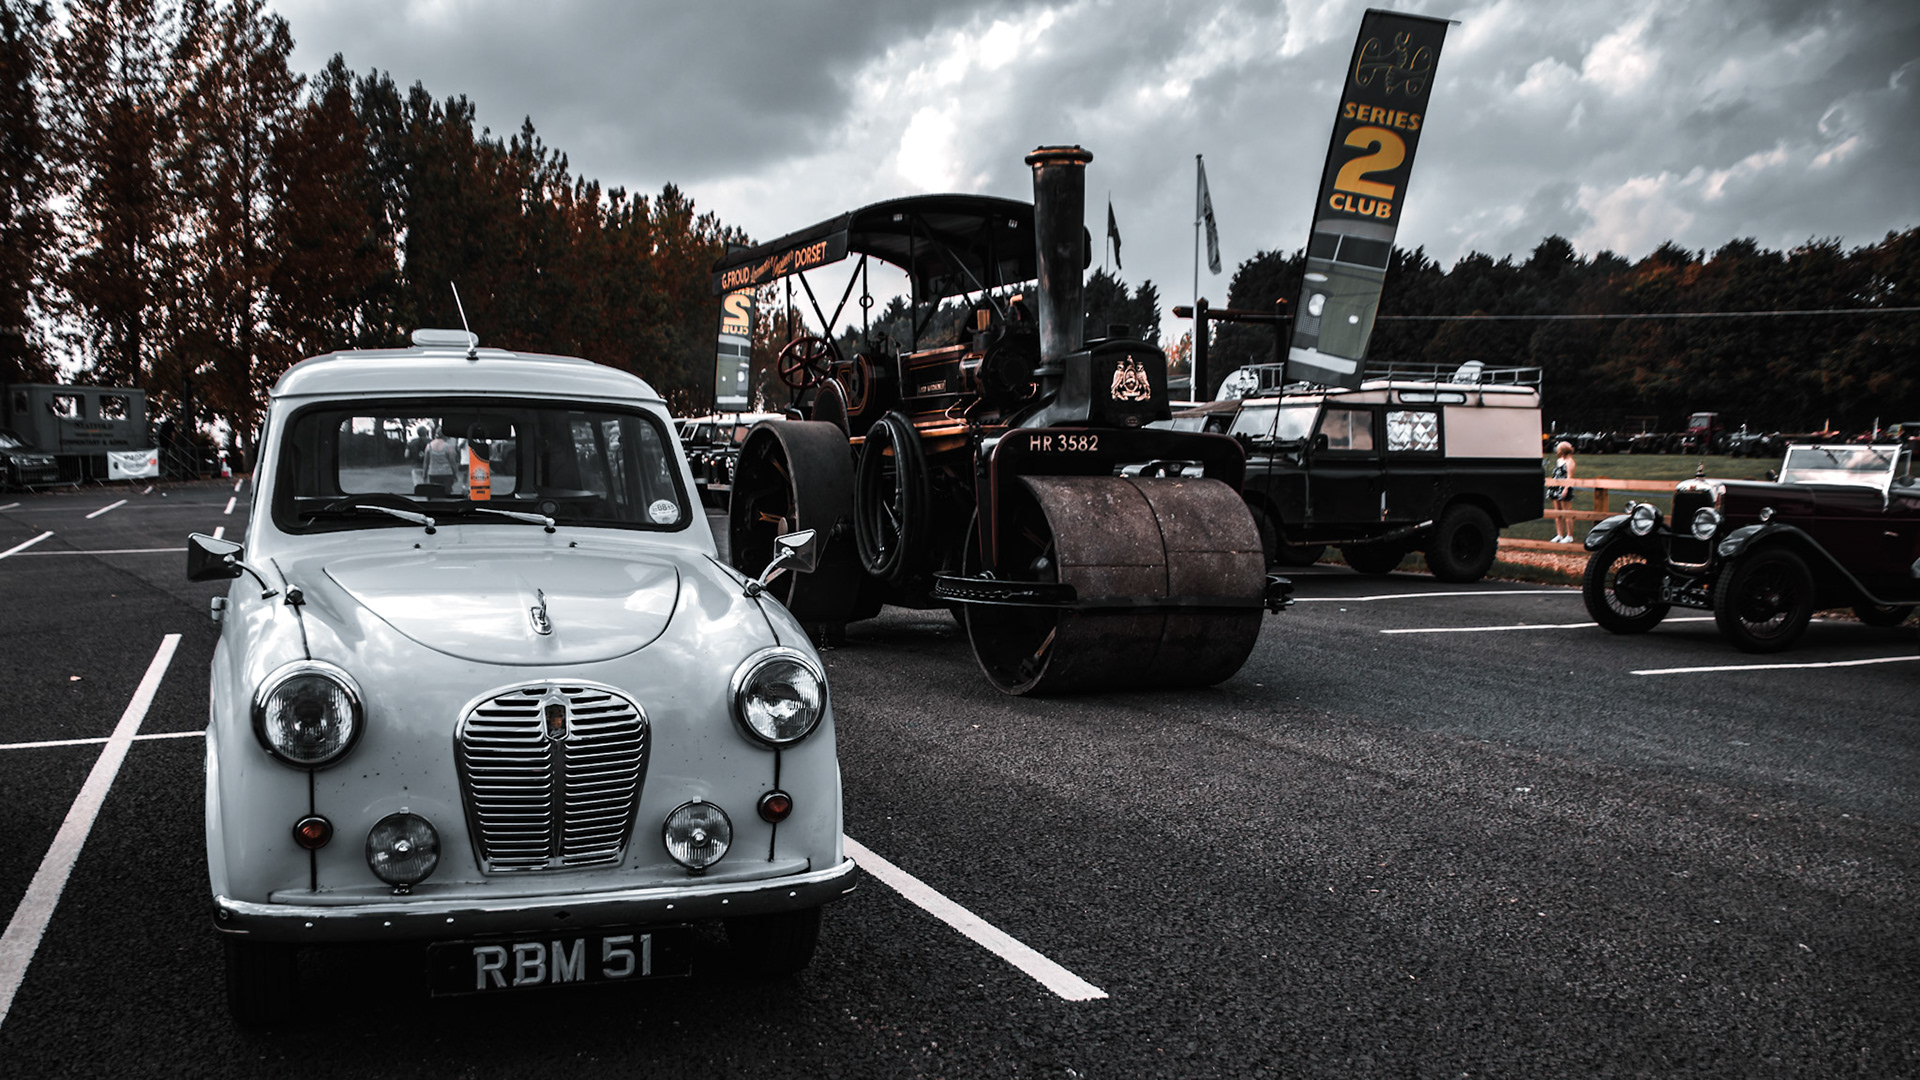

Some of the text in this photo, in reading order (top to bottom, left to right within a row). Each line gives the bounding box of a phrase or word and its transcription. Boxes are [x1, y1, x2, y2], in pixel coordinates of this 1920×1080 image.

[1343, 101, 1421, 131] SERIES
[1333, 125, 1406, 200] 2
[1329, 192, 1393, 219] CLUB
[794, 241, 828, 268] DORSET
[1029, 434, 1099, 452] HR 3582
[472, 933, 652, 990] RBM 51
